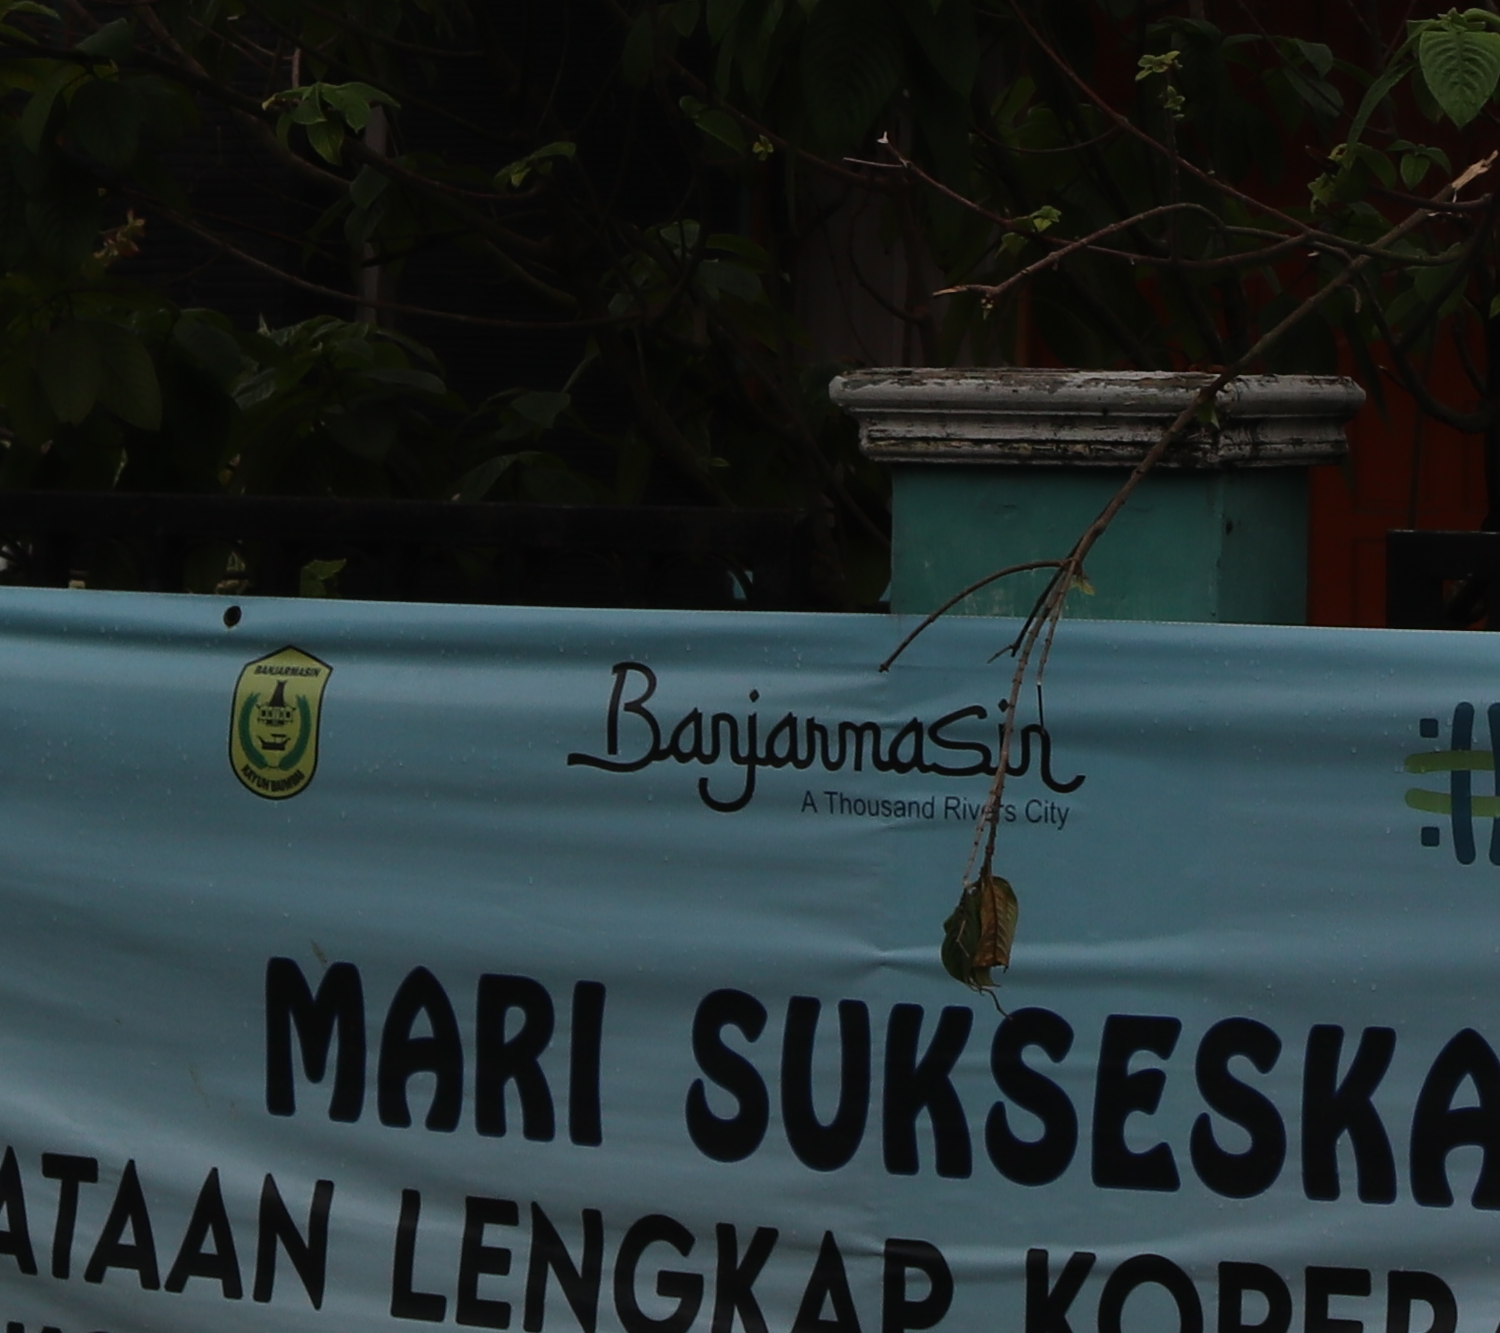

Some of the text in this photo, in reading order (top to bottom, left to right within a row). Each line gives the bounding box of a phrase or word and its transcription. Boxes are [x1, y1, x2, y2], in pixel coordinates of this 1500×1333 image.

[254, 665, 322, 678] BANJARMASIN
[801, 791, 818, 814] A
[824, 792, 936, 821] Thousand
[1024, 799, 1071, 830] City
[265, 957, 606, 1146] MARI
[390, 1189, 953, 1333] LENGKAP
